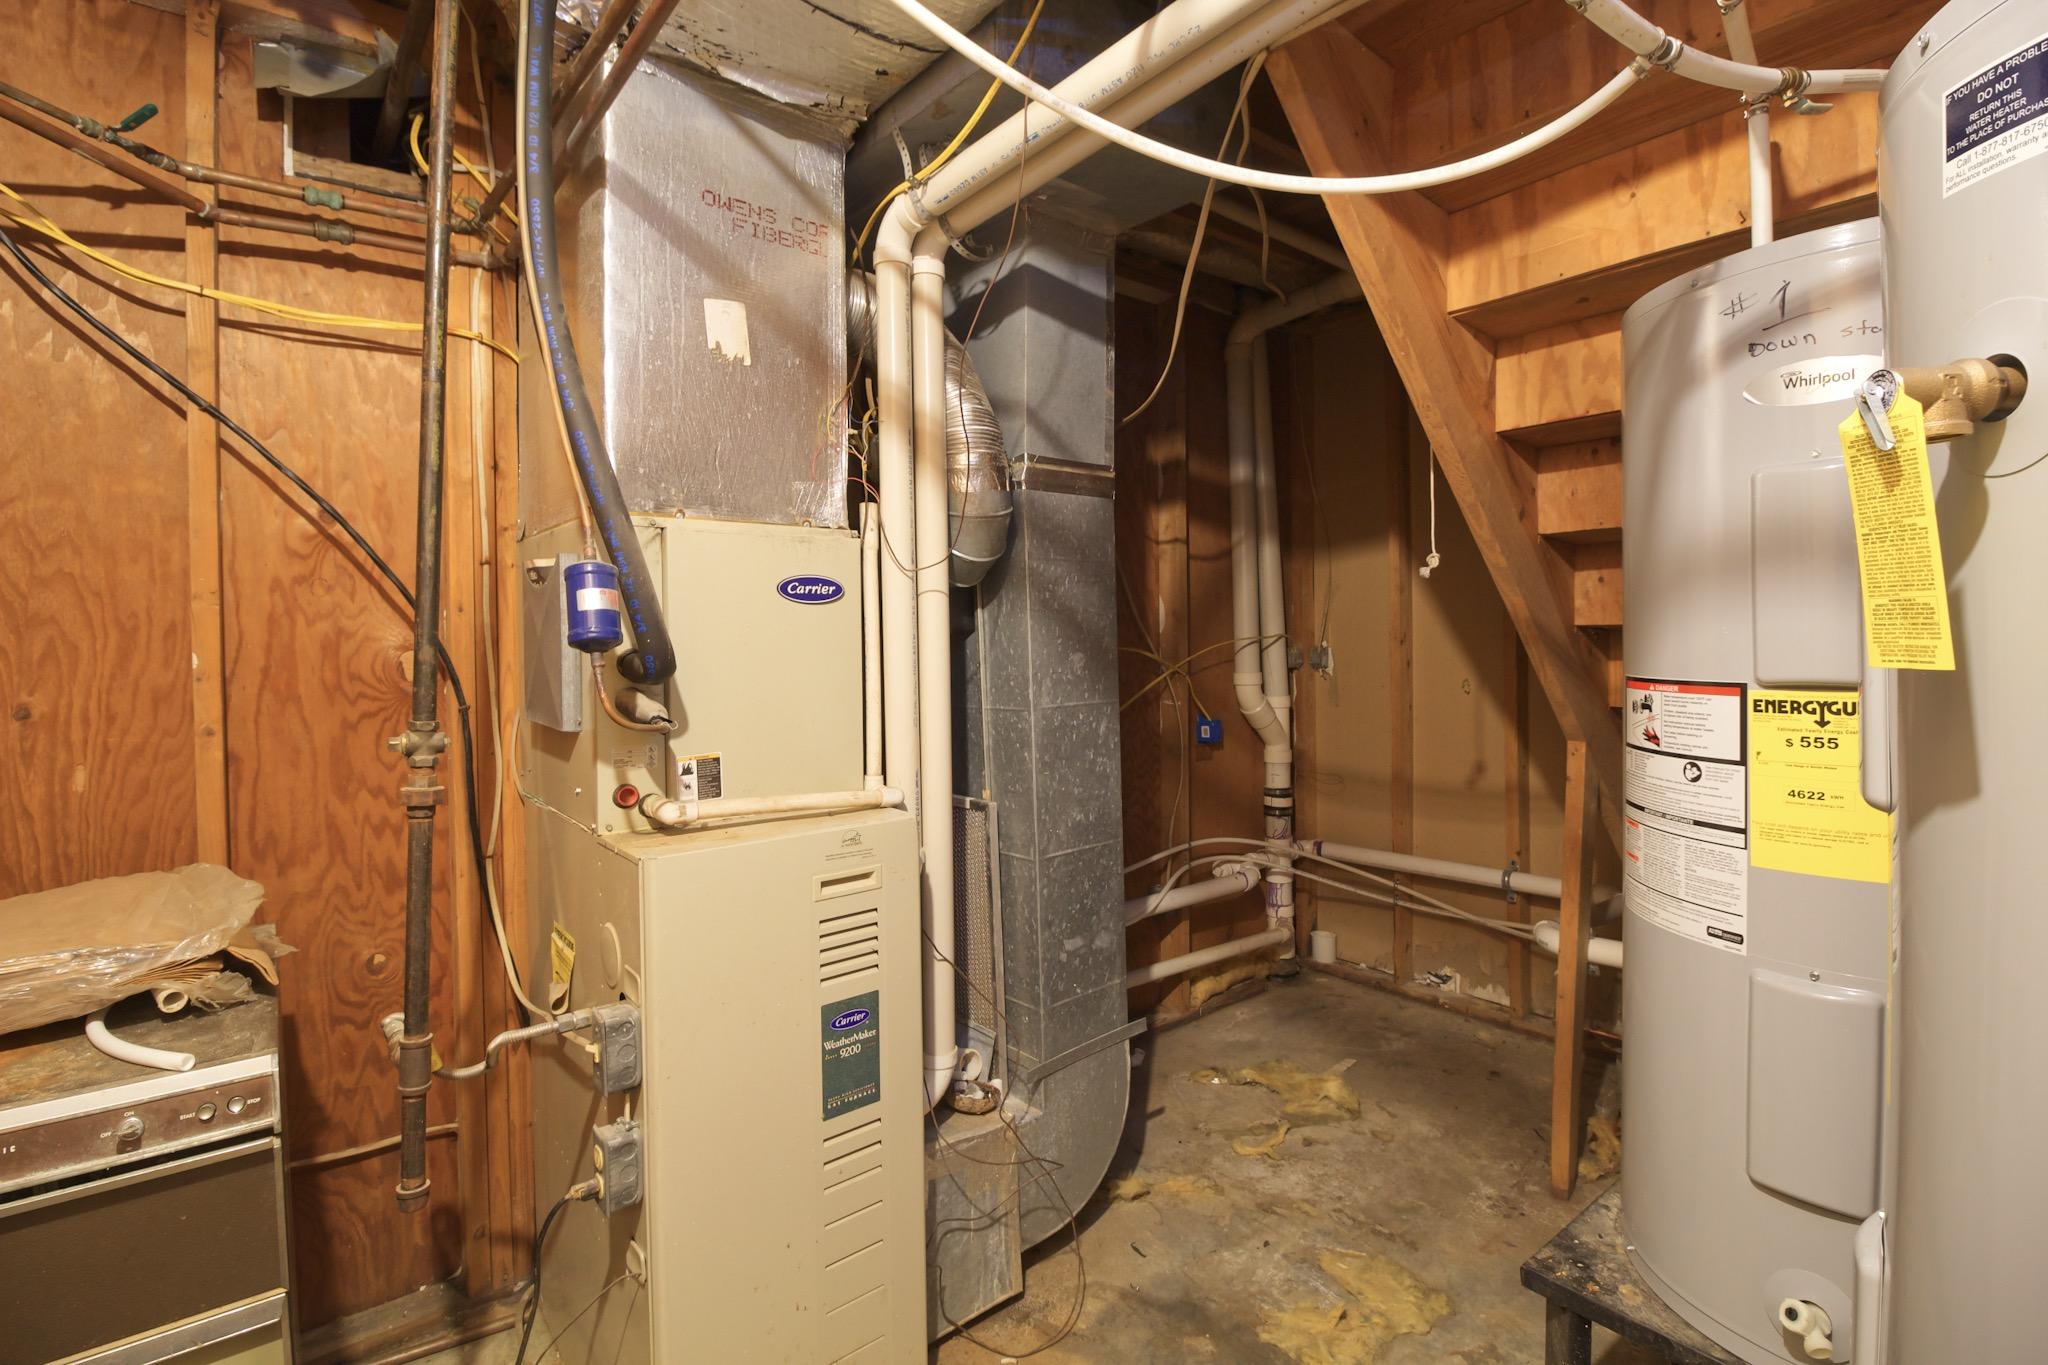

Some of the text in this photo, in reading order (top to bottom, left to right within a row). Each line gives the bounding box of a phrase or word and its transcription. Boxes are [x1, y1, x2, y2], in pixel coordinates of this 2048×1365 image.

[1953, 83, 1970, 100] YOU
[1971, 68, 1996, 89] HAVE
[1997, 65, 2004, 75] A
[2005, 40, 2048, 71] PROBLE
[1977, 72, 2019, 104] DO NOT
[1965, 96, 2027, 134] WATER HEATER
[1969, 88, 2022, 122] RETURN THIS
[1947, 146, 1955, 156] TO
[1956, 137, 1968, 150] THE
[1969, 125, 1993, 143] PLACE
[1994, 118, 2006, 130] OF
[2006, 135, 2040, 154] warranty
[1956, 152, 1971, 169] Call
[702, 189, 777, 225] OWENS
[1783, 368, 1855, 390] Whirlpool
[787, 582, 836, 594] Carrier
[1753, 699, 1860, 725] ENERGYGU
[1786, 736, 1839, 750] $ 555
[1788, 789, 1825, 801] 4622
[836, 1012, 866, 1027] Carrier
[823, 1029, 877, 1051] WeatherMaker
[840, 1043, 861, 1058] 9200
[179, 1112, 196, 1121] START
